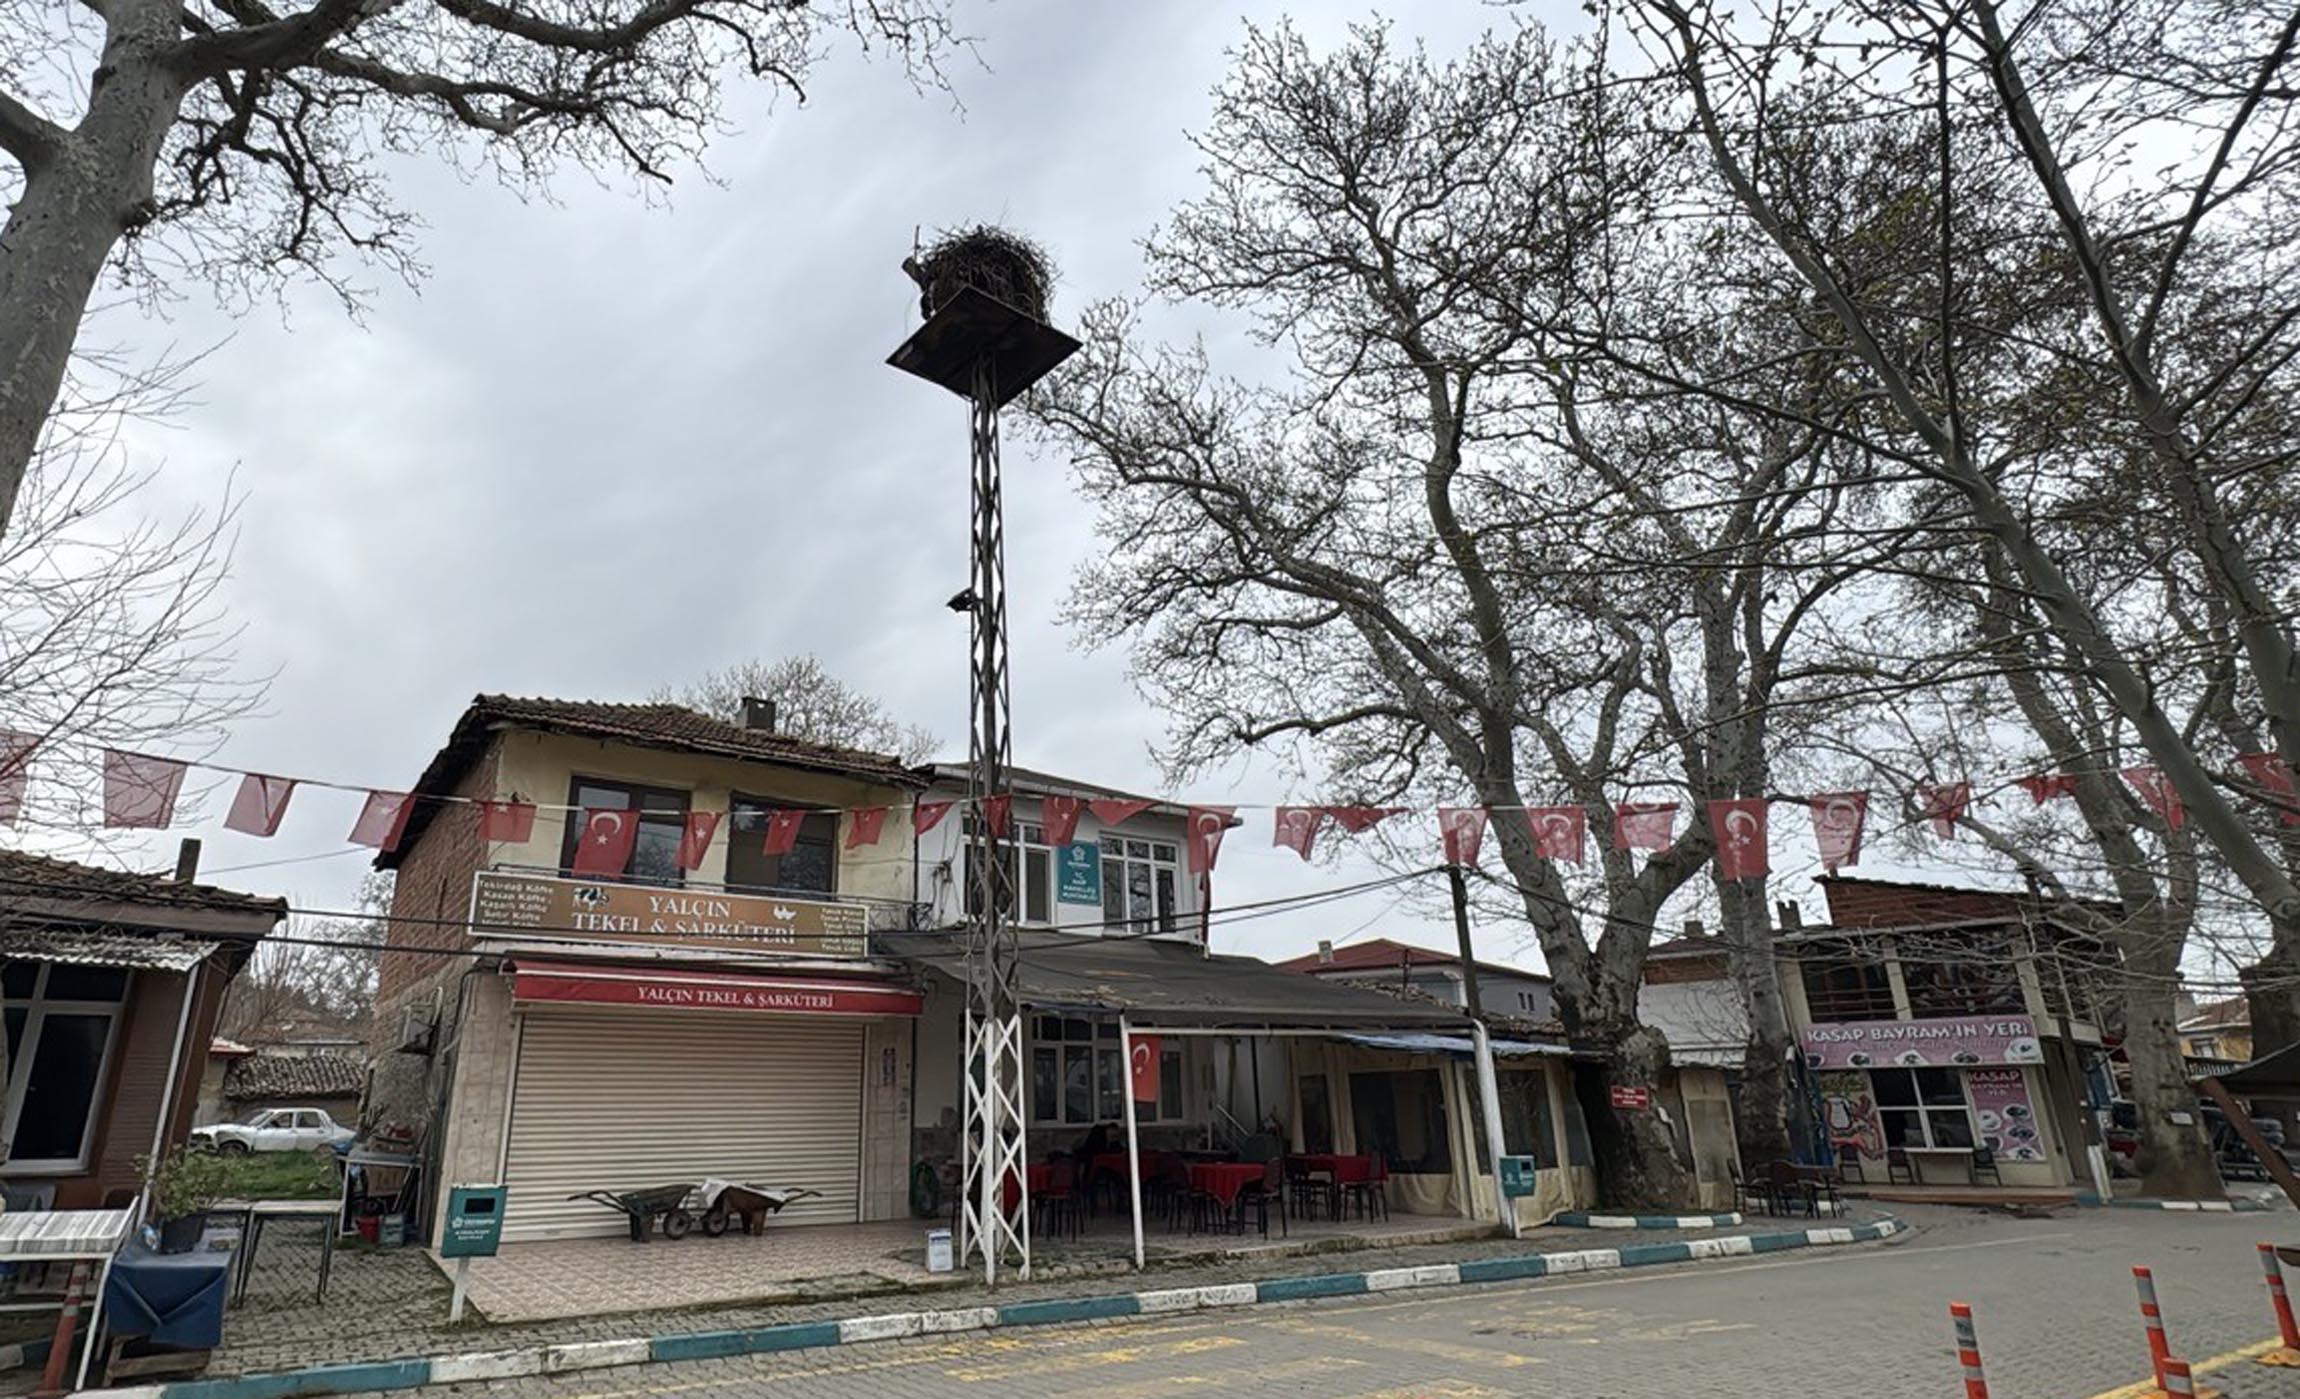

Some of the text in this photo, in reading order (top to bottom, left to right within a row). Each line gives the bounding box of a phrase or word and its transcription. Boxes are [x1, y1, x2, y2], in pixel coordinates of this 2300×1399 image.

[650, 896, 731, 919] YALÇIN
[650, 919, 668, 934] &
[675, 919, 797, 945] ŞARKÜTERİ
[638, 986, 833, 1008] YALÇIN TEKEL & ŞARKÜTERİ
[1807, 1028, 1865, 1043] KASAP
[1871, 1024, 1976, 1041] BAYRAM'IN
[1968, 1070, 2020, 1081] KASAP
